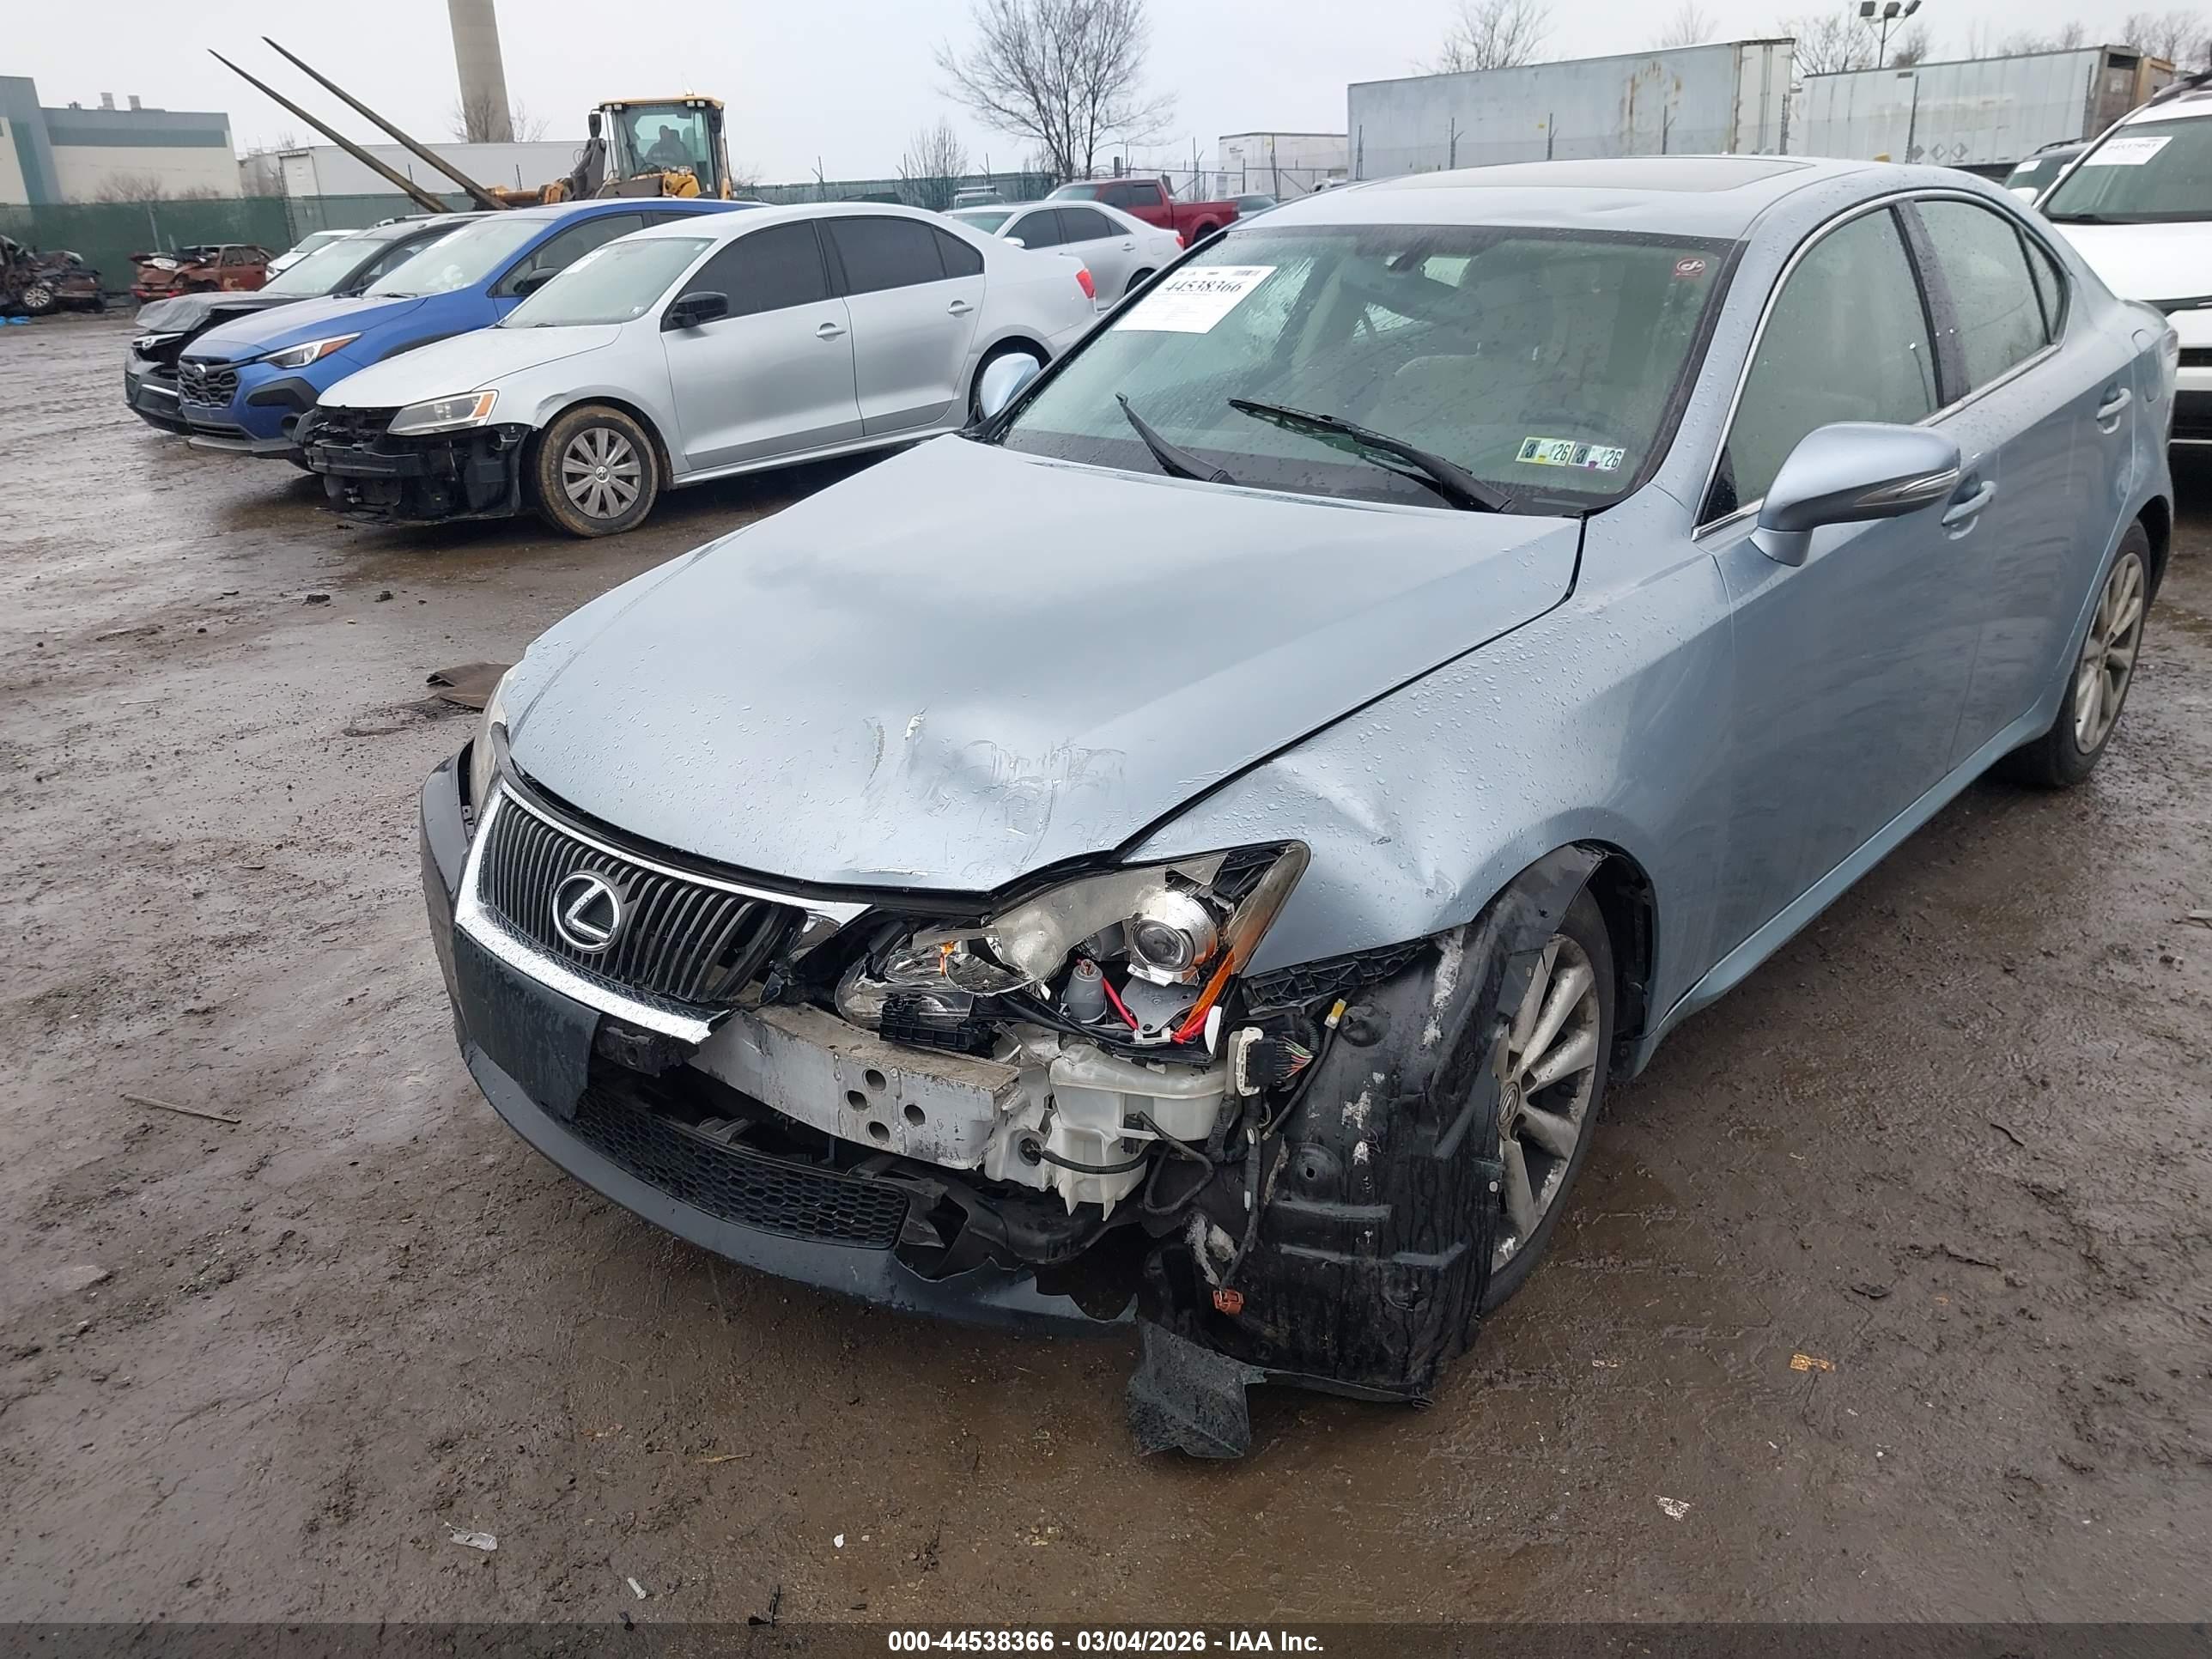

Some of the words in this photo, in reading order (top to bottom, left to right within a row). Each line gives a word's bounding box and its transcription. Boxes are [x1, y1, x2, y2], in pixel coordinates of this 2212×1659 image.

[1164, 280, 1248, 293] 44538366
[1524, 443, 1536, 459] 3
[1553, 443, 1571, 461] 26
[1576, 447, 1588, 465] 3
[1604, 450, 1622, 468] 26
